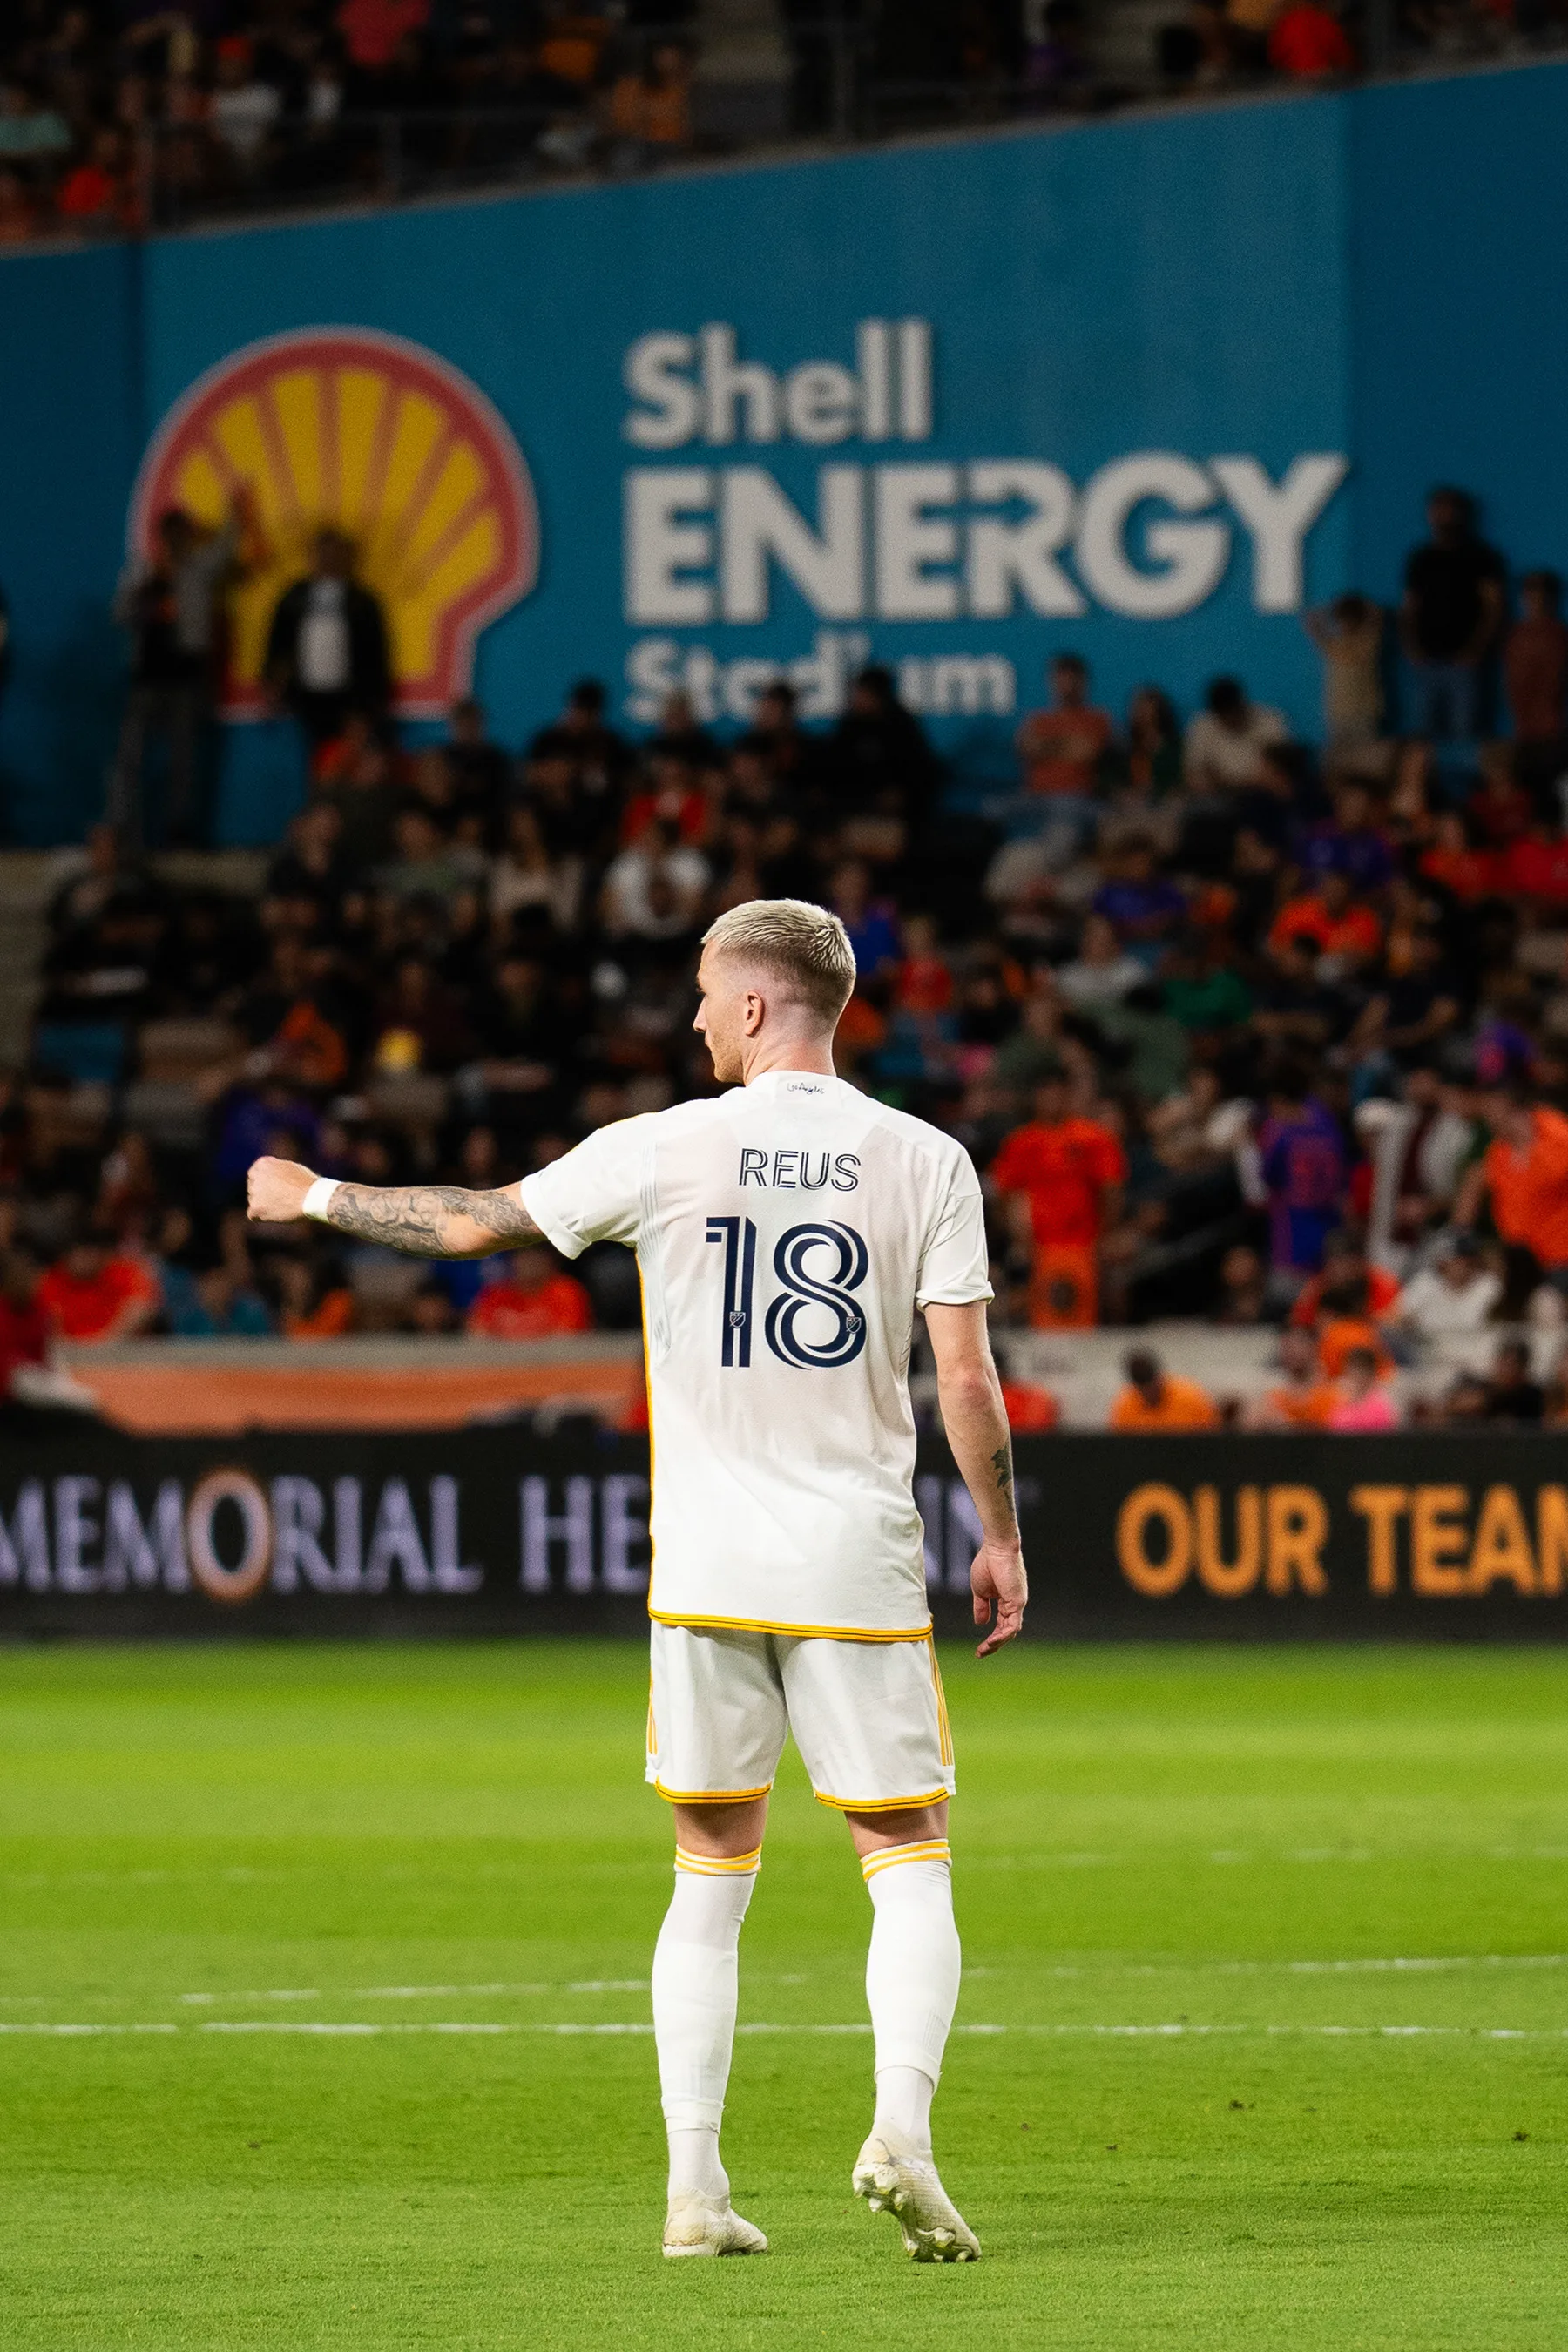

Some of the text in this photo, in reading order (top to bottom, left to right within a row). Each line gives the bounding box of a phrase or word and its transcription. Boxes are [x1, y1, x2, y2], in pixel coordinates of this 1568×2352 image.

[625, 317, 931, 448] Shell
[625, 451, 1348, 623] ENERGY
[739, 1148, 861, 1192] REUS
[706, 1216, 869, 1371] 18
[1117, 1483, 1328, 1595] OUR
